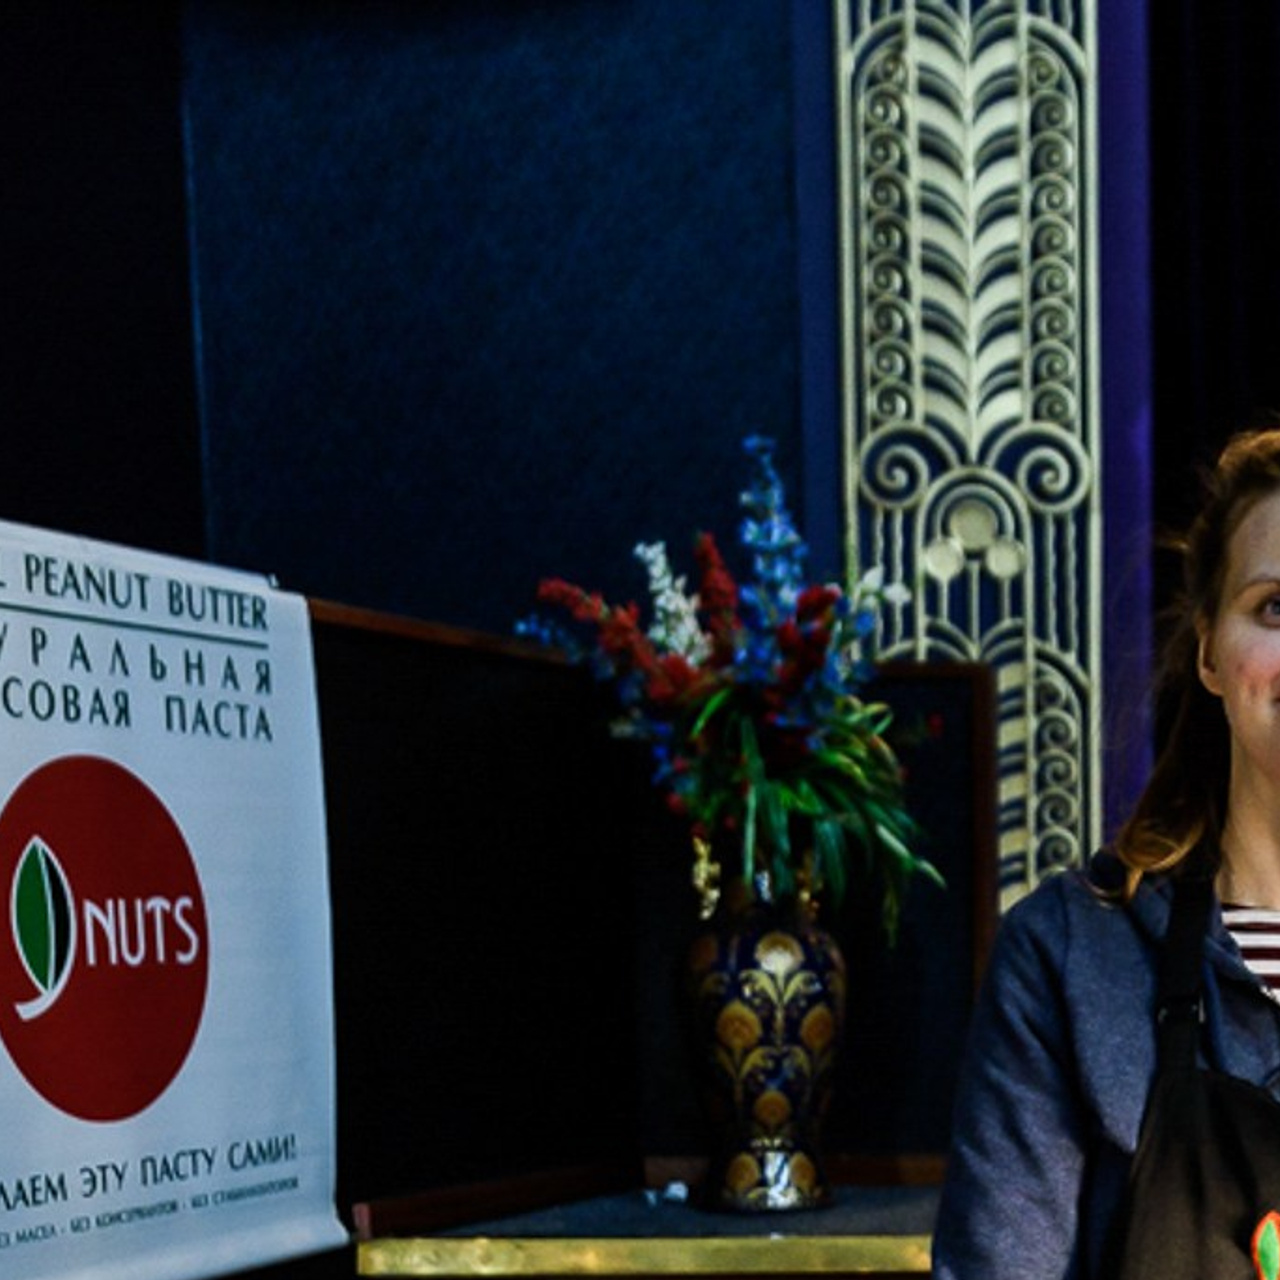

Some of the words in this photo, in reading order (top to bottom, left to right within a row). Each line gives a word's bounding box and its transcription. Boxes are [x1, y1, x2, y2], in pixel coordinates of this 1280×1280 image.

[25, 553, 150, 610] PEANUT
[167, 578, 268, 631] BUTTER
[164, 694, 274, 742] ПАСТА
[83, 896, 200, 966] NUTS
[80, 1162, 129, 1199] ЭТУ
[140, 1146, 218, 1187] ПАСТУ
[227, 1133, 297, 1171] САМИ!
